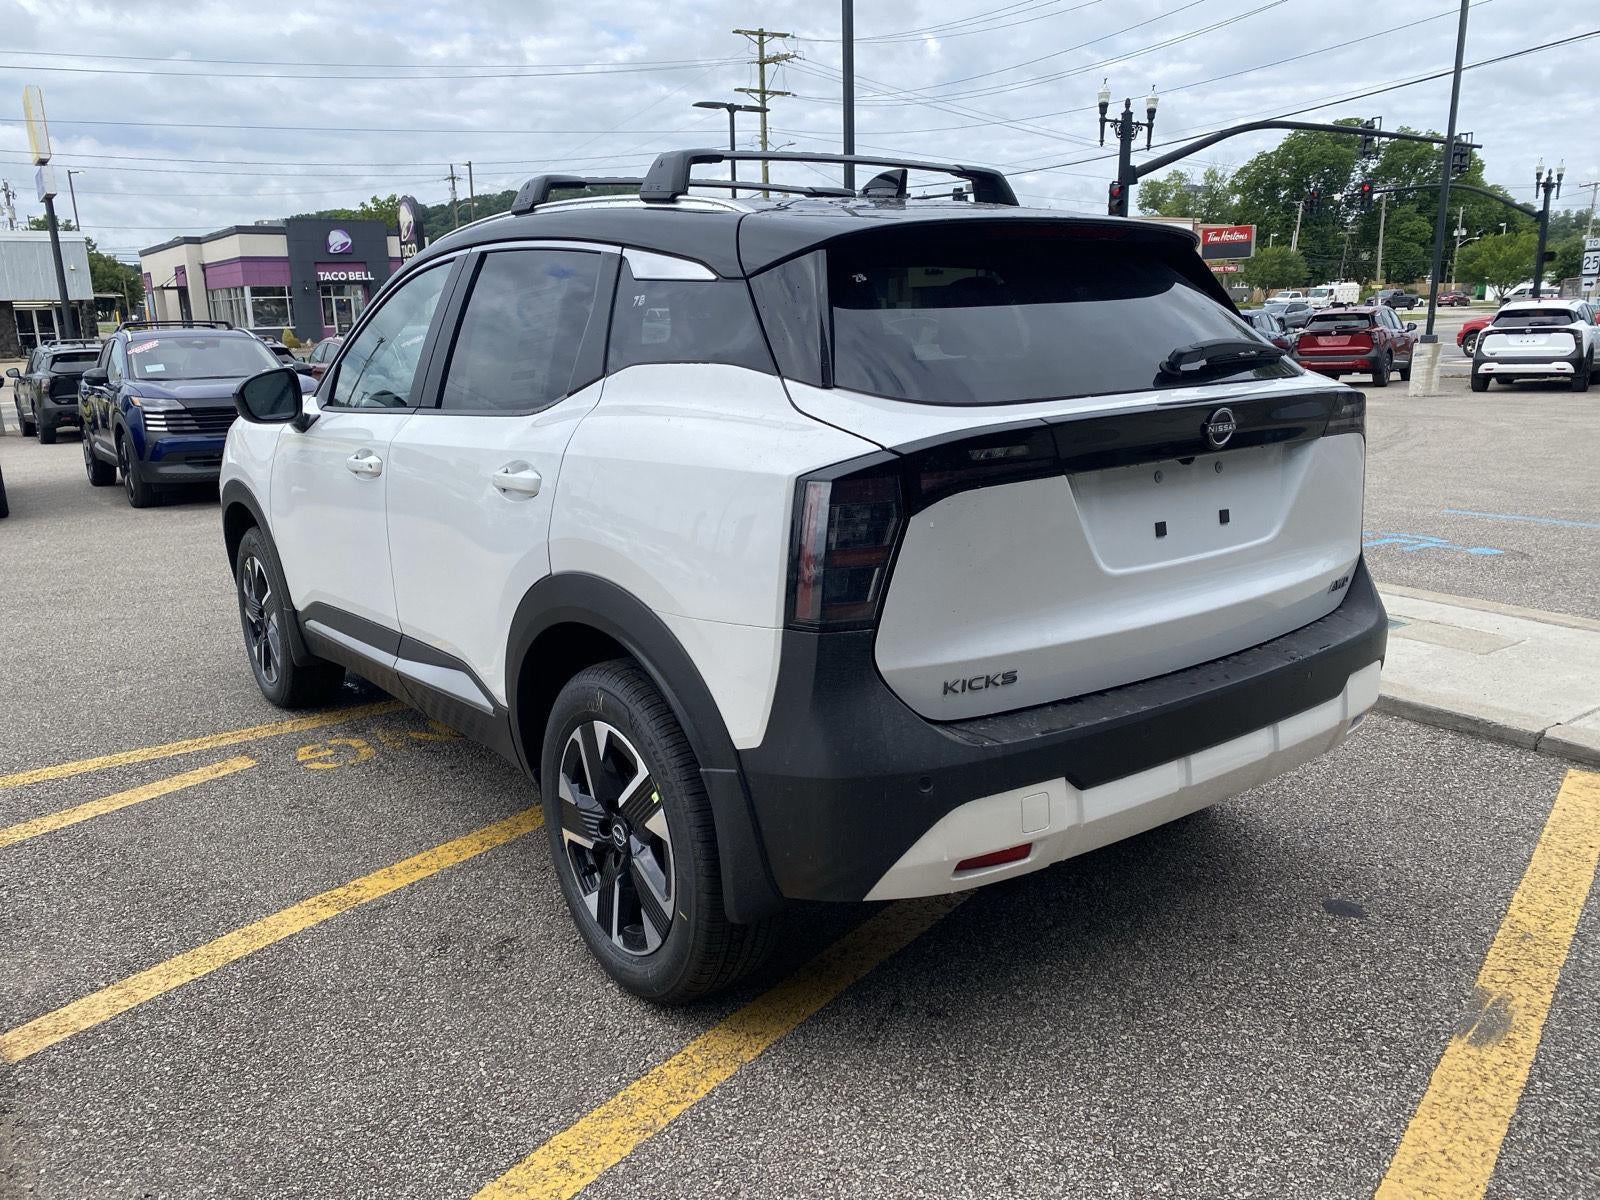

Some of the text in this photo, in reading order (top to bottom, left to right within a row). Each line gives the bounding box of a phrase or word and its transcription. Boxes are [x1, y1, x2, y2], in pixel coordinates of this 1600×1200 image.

[1207, 230, 1248, 243] Tim Hortons
[1588, 239, 1599, 247] TO
[401, 243, 417, 259] TACO
[1584, 255, 1600, 270] 25
[318, 271, 374, 281] TACO BELL
[943, 669, 1018, 695] KICKS
